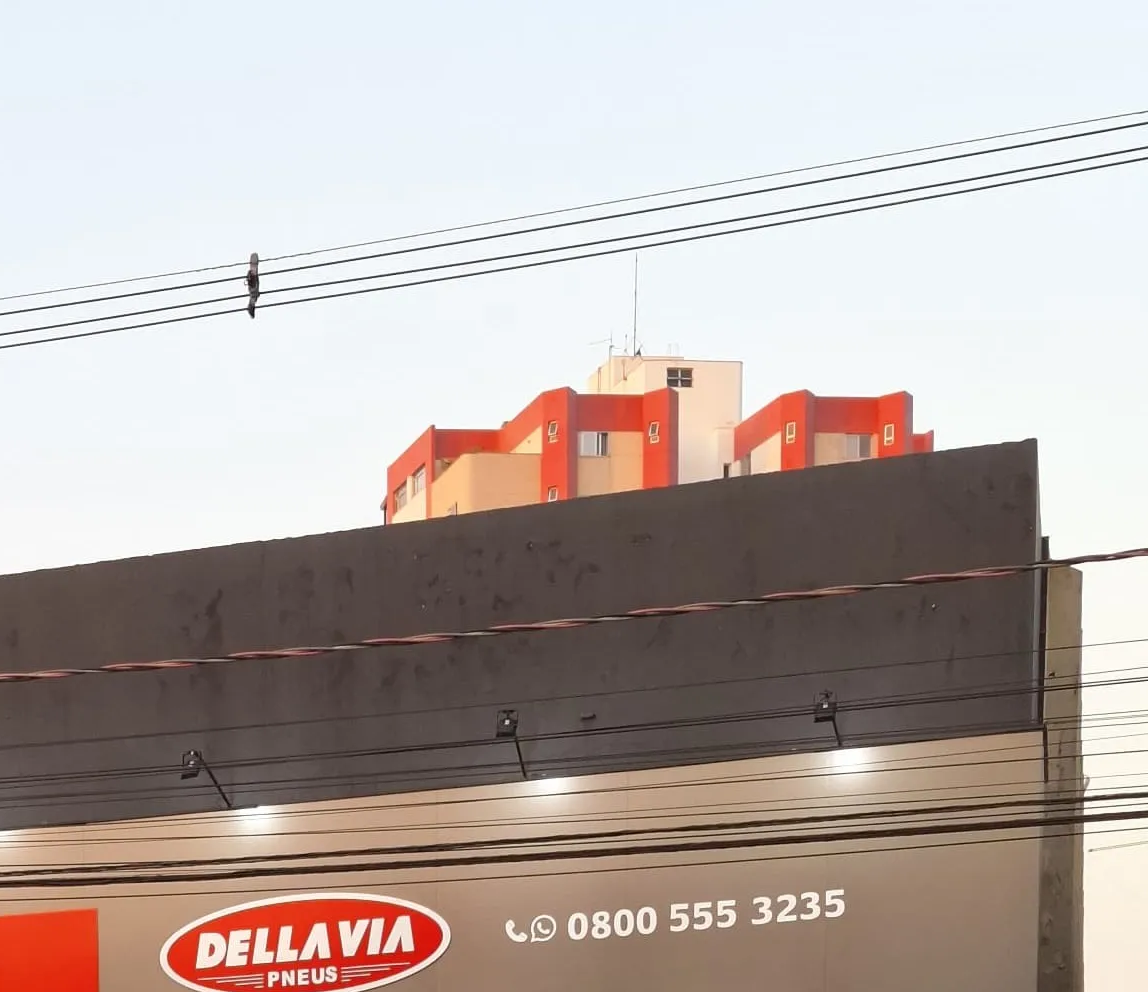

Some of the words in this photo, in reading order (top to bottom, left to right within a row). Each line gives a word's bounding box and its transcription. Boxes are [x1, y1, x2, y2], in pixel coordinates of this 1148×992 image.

[567, 906, 658, 941] 0800
[669, 899, 737, 932] 555
[751, 889, 846, 926] 3235
[267, 966, 338, 988] PNEUS
